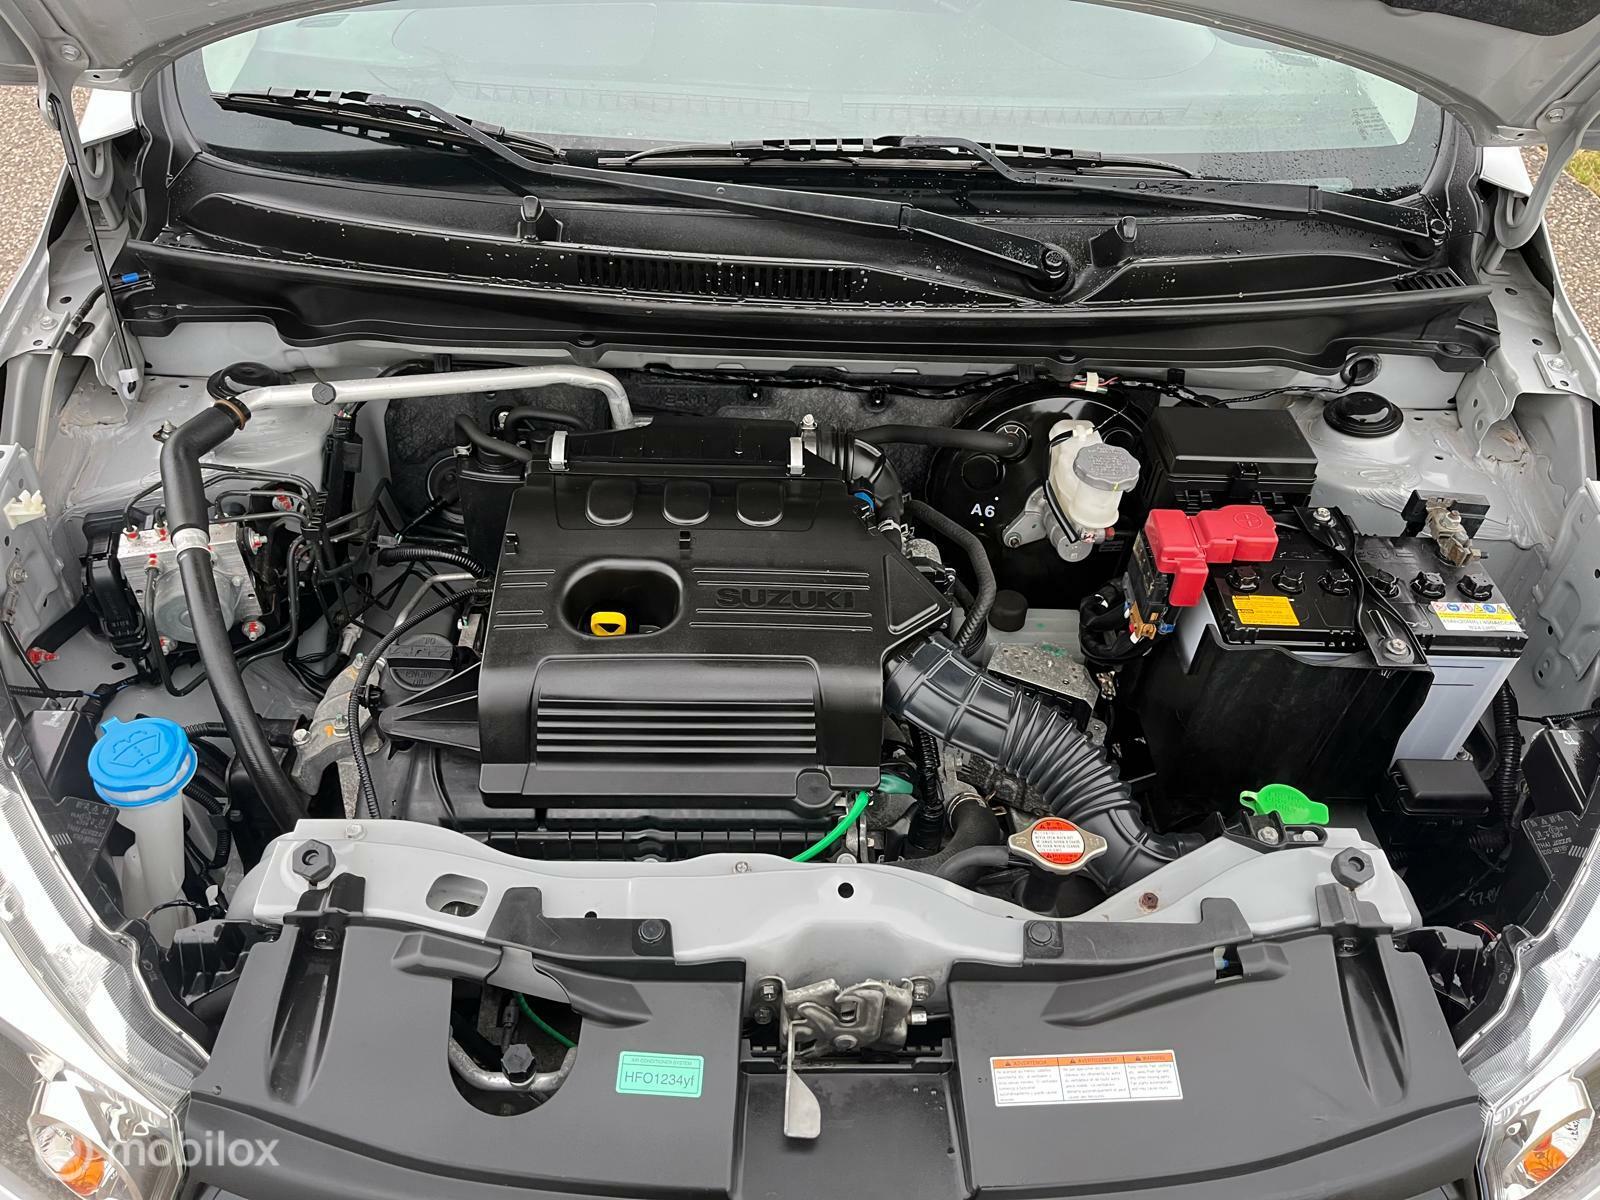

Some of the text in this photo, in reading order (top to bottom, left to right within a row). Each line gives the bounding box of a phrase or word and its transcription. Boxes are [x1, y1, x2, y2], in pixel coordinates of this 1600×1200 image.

[970, 503, 996, 518] A6
[715, 587, 855, 609] SUZUKI
[624, 1071, 695, 1088] HFO1234yf
